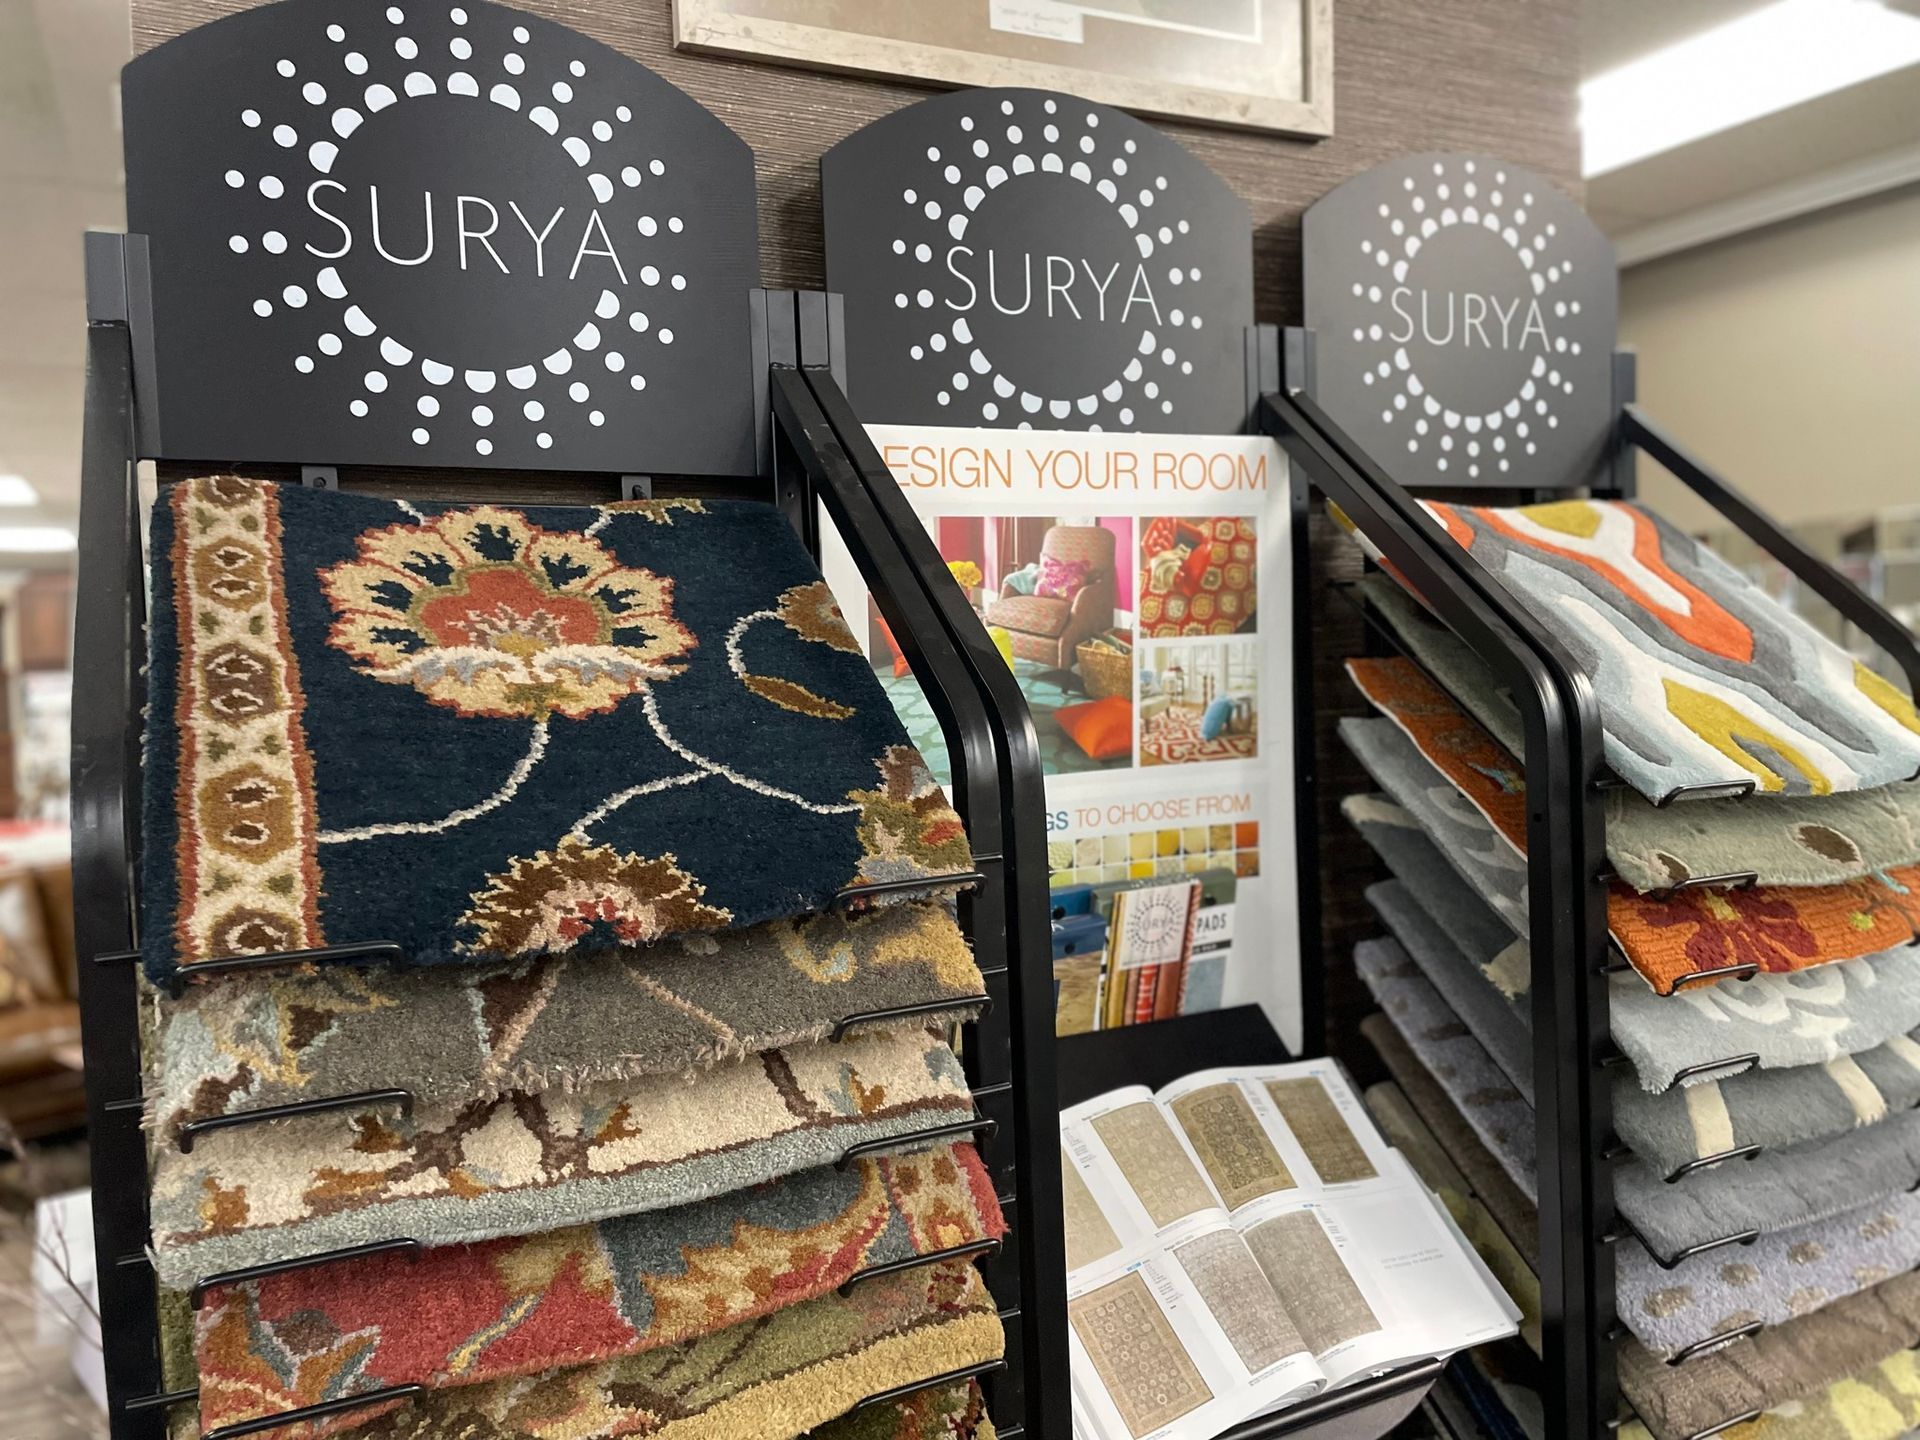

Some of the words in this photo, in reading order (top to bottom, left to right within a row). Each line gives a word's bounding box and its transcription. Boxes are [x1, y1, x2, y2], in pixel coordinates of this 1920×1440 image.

[304, 178, 629, 285] SURYA
[944, 245, 1163, 327] SURYA
[1389, 286, 1552, 353] SURYA
[883, 445, 1012, 489] ESIGN
[1026, 449, 1139, 490] YOUR
[1153, 452, 1268, 491] ROOM
[1075, 807, 1101, 828] TO
[1107, 799, 1190, 825] CHOOSE
[1196, 793, 1251, 815] FROM
[1197, 913, 1228, 933] PADS
